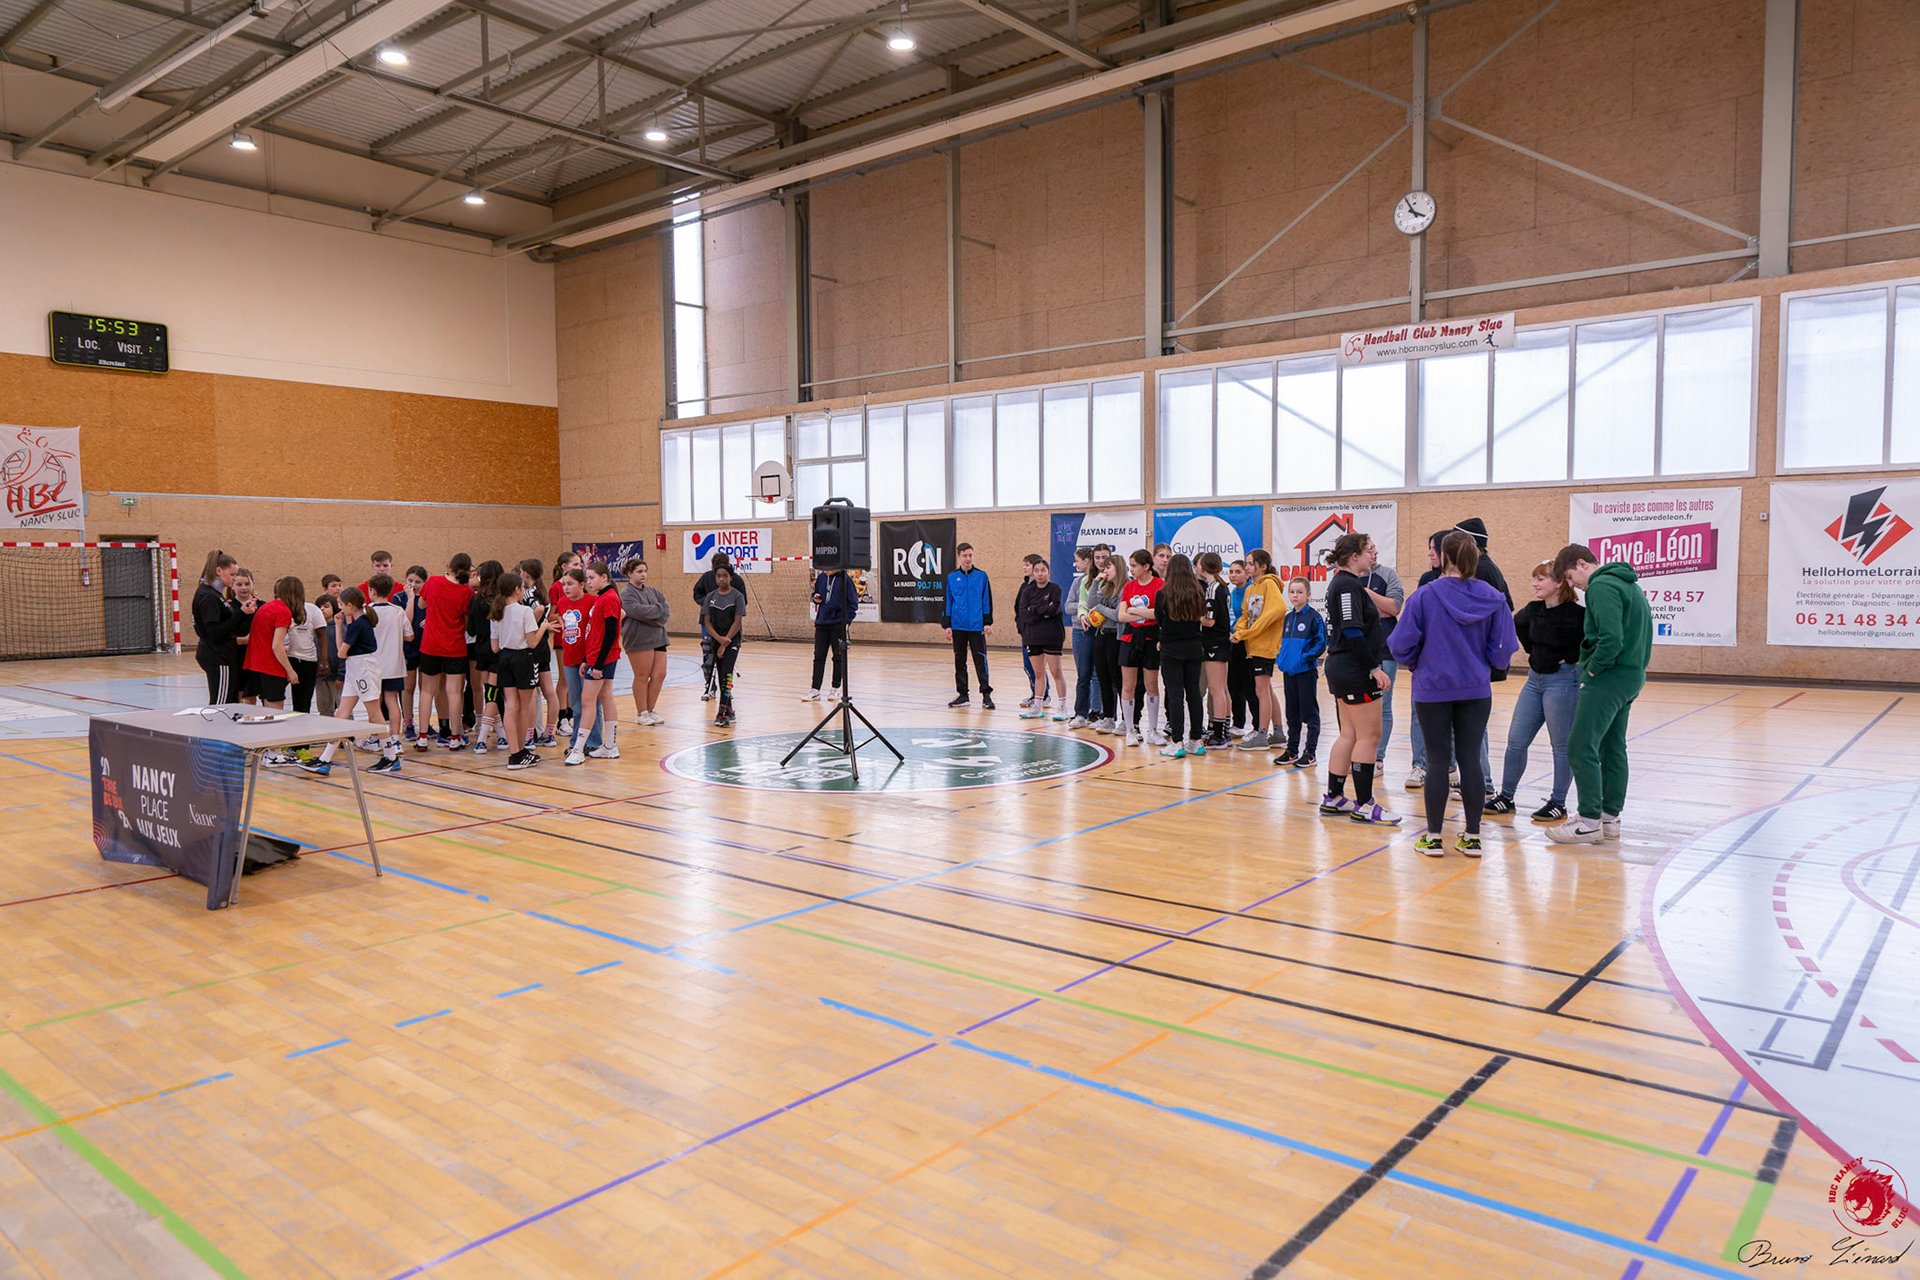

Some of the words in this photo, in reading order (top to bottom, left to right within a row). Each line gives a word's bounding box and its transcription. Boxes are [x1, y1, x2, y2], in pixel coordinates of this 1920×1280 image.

[88, 318, 138, 336] 15:53
[1363, 328, 1409, 346] Handball
[1412, 326, 1437, 340] Club
[1440, 323, 1474, 338] Nancy
[1477, 318, 1503, 332] Sluc
[1376, 338, 1478, 357] www.hbcnancysluc.com
[7, 481, 74, 513] HBC
[1593, 502, 1603, 514] Un
[1604, 501, 1631, 514] caviste
[1632, 503, 1646, 515] pas
[1647, 500, 1674, 512] comme
[1675, 499, 1688, 511] les
[1689, 498, 1714, 511] autres
[20, 513, 54, 527] NANCY
[57, 508, 81, 521] SLUC
[1612, 513, 1693, 522] www.lacavedeleon.fr
[718, 531, 758, 545] INTER
[1081, 528, 1106, 536] RAYAN
[1107, 528, 1126, 536] DEM
[1128, 527, 1138, 535] 54
[1172, 542, 1195, 557] Guy
[1198, 542, 1239, 555] Hoquet
[1600, 537, 1644, 565] Cave
[1644, 548, 1655, 564] de
[1656, 528, 1703, 563] Léon
[893, 540, 942, 580] RCN
[1632, 563, 1654, 571] AGNES
[1280, 565, 1327, 581] BATIM
[916, 581, 932, 589] 90.7
[932, 581, 943, 589] FM
[1663, 590, 1682, 602] 84
[1685, 590, 1705, 602] 57
[1833, 592, 1865, 600] générale
[1871, 592, 1914, 600] Dépannage
[1795, 612, 1818, 625] 06
[1825, 613, 1846, 626] 21
[1854, 613, 1877, 626] 48
[1884, 613, 1908, 627] 34
[1673, 630, 1721, 638] la.cave.de.leon
[1818, 629, 1915, 638] hellohomelor@gmail.com
[132, 764, 176, 798] NANCY
[140, 794, 169, 821] PLACE
[156, 824, 182, 848] JEUX
